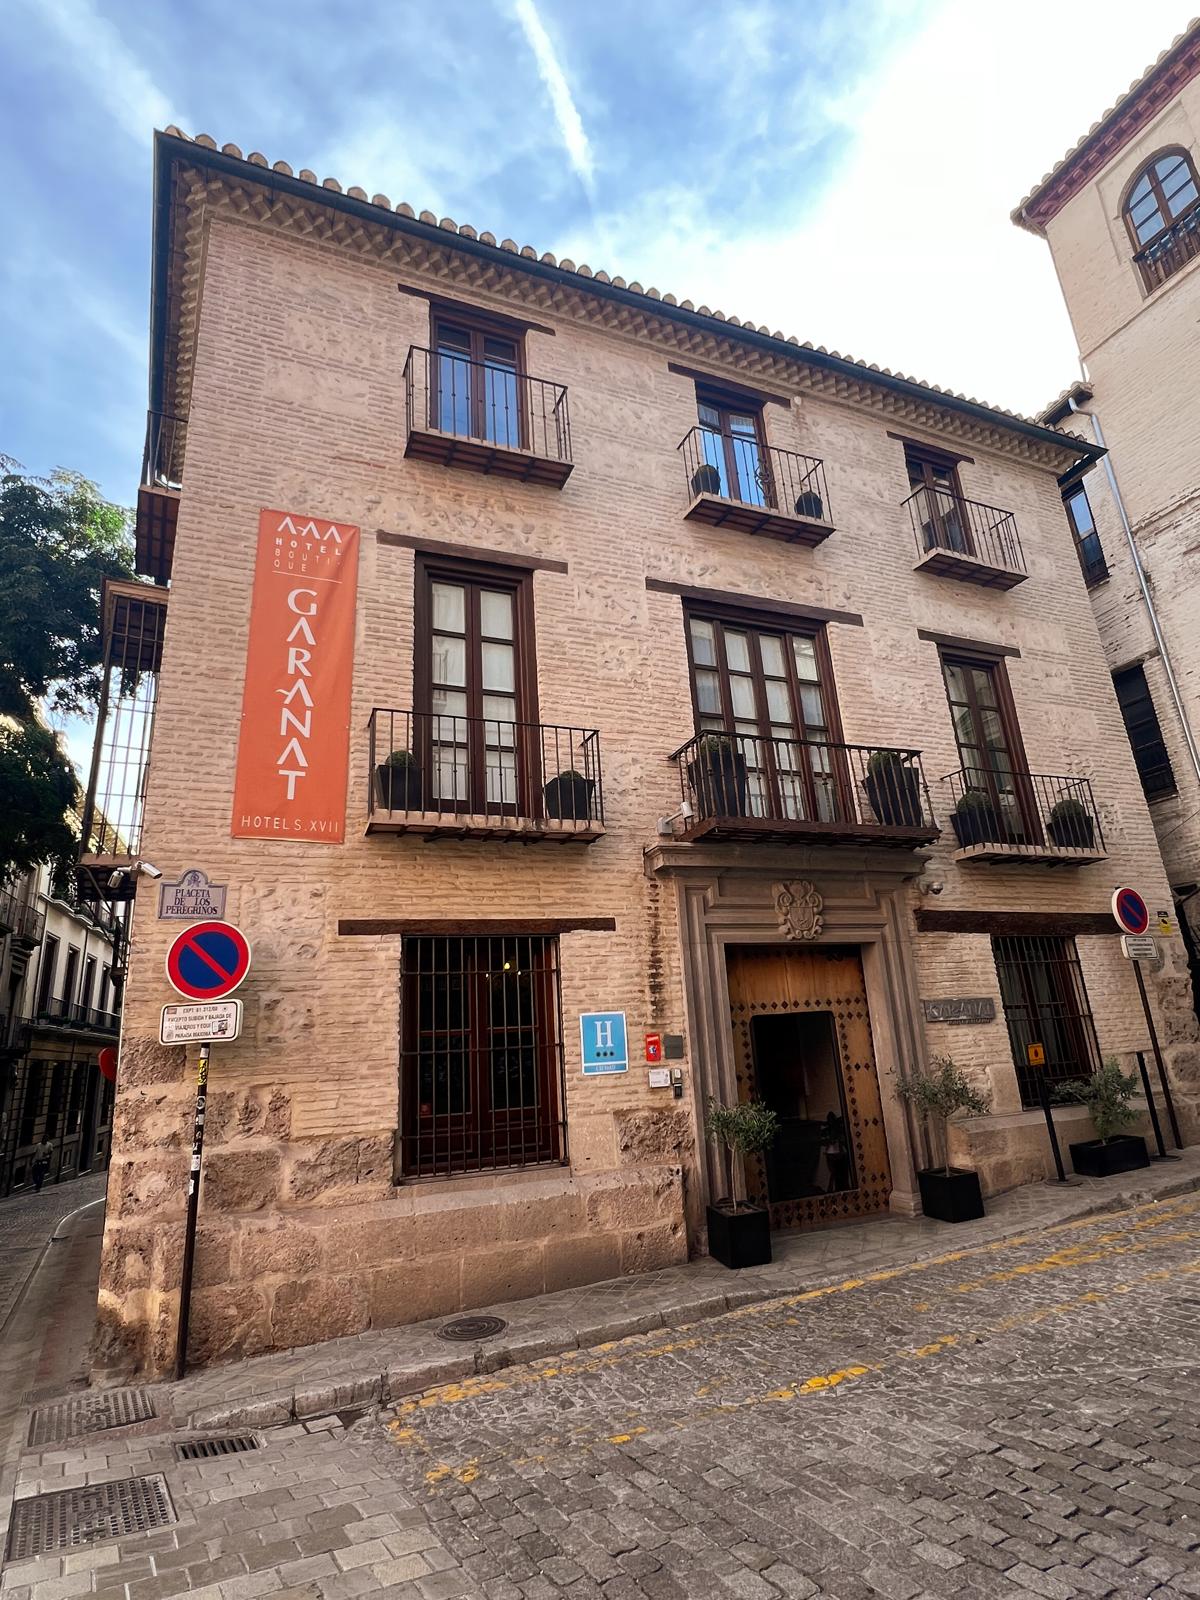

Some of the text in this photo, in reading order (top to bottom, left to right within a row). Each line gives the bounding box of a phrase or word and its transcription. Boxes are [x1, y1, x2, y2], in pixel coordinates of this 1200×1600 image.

[275, 537, 342, 556] HOTEL
[273, 559, 307, 572] QUE
[275, 588, 318, 801] GARANAT
[175, 888, 210, 897] PLACETA
[174, 898, 211, 906] DE LOS
[165, 906, 219, 915] PEREGRINOS
[594, 1020, 615, 1048] H
